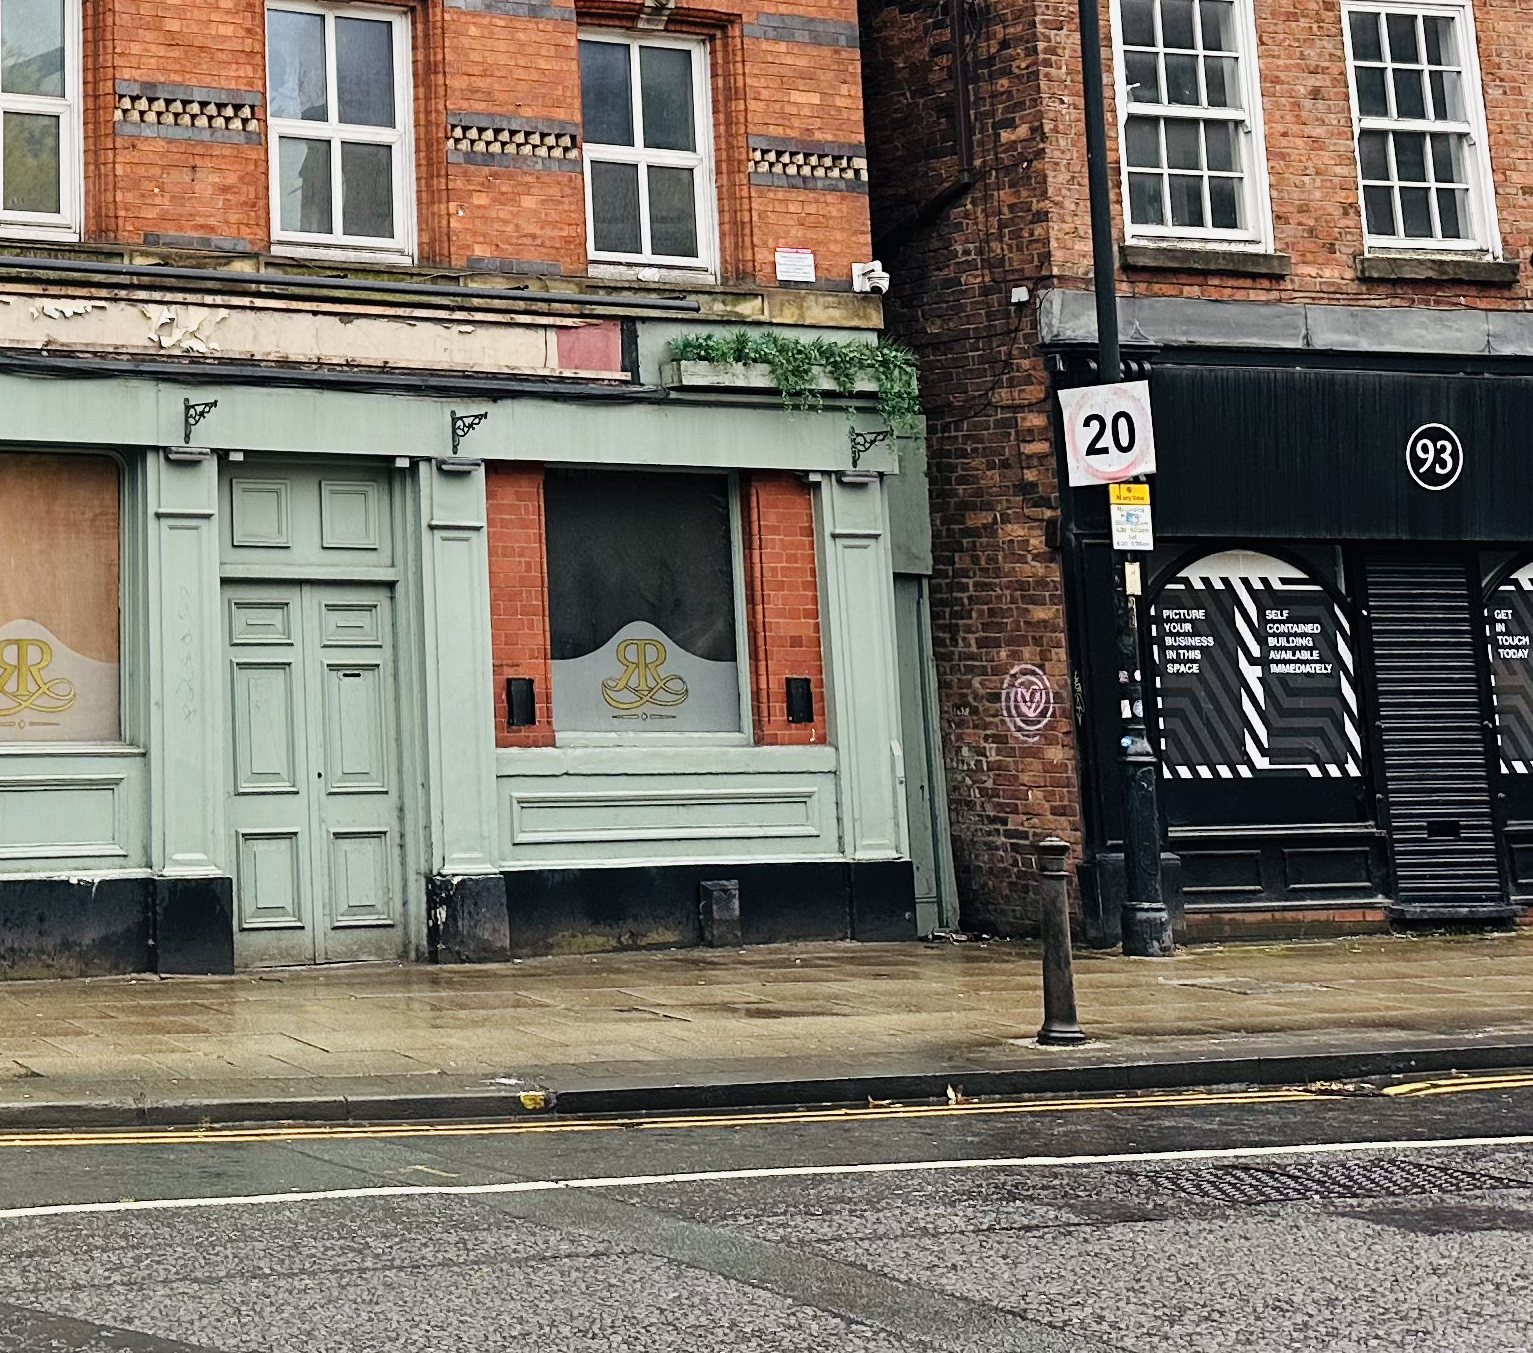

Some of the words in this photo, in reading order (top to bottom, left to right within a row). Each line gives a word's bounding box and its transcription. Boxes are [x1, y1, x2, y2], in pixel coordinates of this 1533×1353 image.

[1082, 410, 1136, 457] 20
[1415, 438, 1453, 475] 93
[1162, 609, 1206, 620] PICTURE
[1265, 609, 1290, 620] SELF
[1494, 609, 1513, 620] GET
[1163, 622, 1193, 633] YOUR
[1266, 623, 1322, 634] CONTAINED
[1495, 622, 1506, 633] IN
[1164, 636, 1215, 647] BUSINESS
[1267, 636, 1314, 647] BUILDING
[1496, 635, 1530, 646] TOUCH
[1165, 649, 1178, 660] IN
[1179, 649, 1202, 660] THIS
[1268, 650, 1320, 660] AVAILABLE
[1497, 648, 1530, 659] TODAY
[1166, 663, 1200, 674] SPACE
[1269, 663, 1333, 674] IMMEDIATELY
